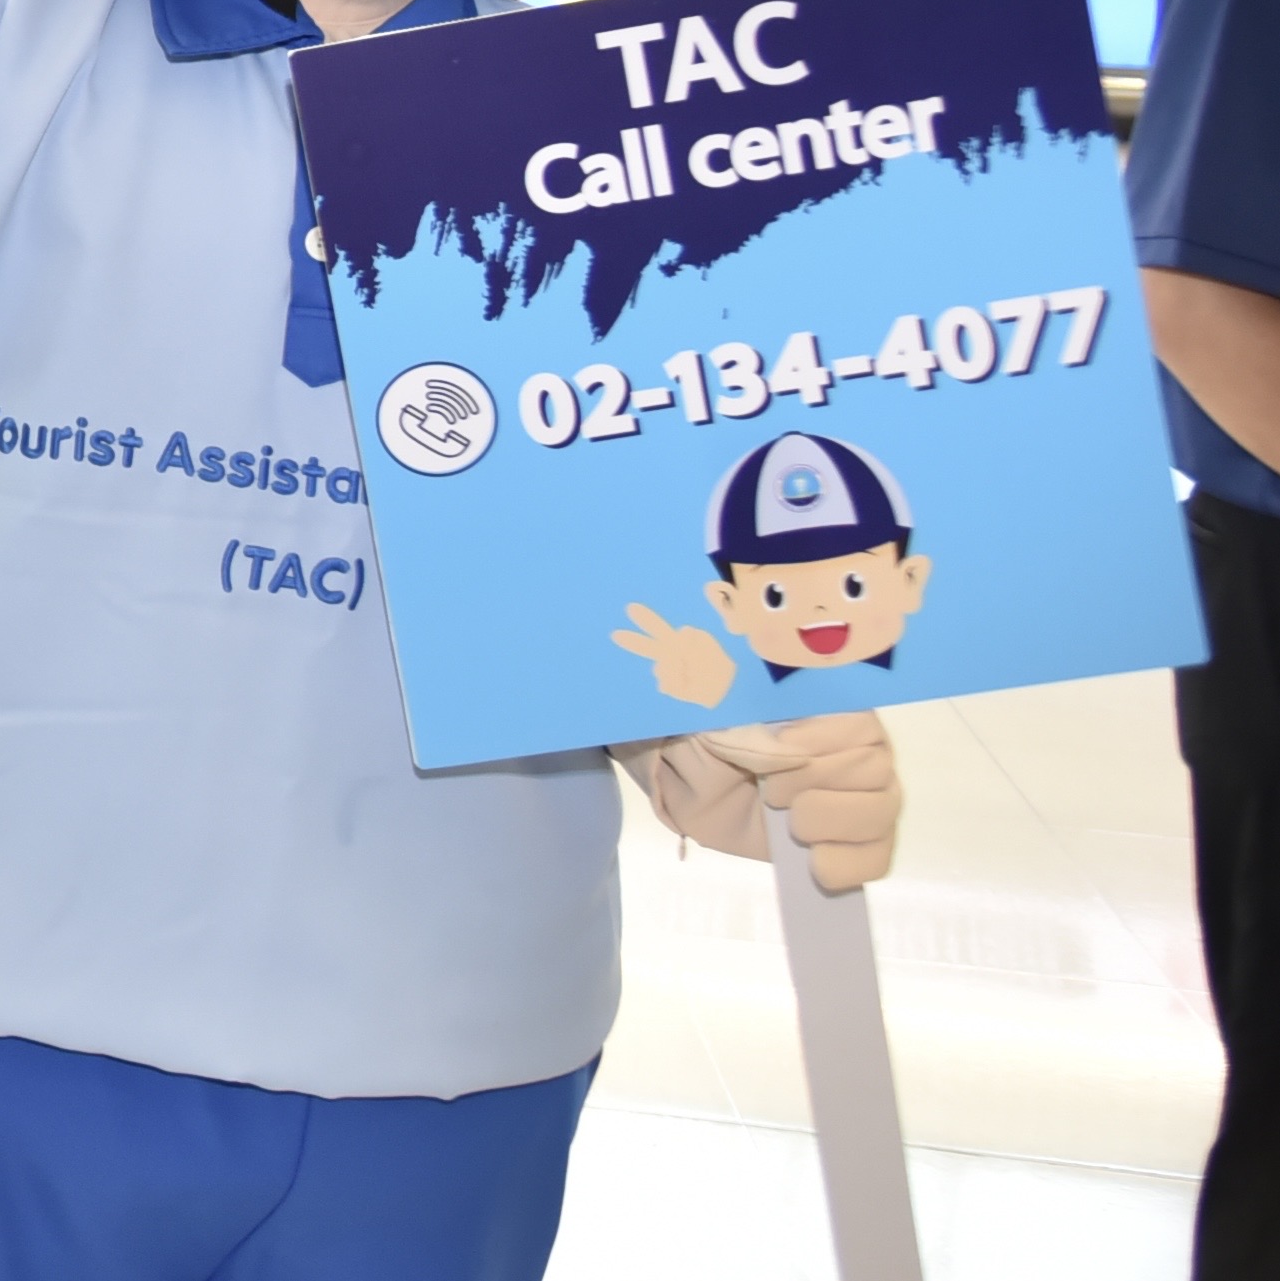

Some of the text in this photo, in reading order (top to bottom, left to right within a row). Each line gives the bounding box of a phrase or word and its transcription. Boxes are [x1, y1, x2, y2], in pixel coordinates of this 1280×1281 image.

[594, 0, 810, 109] TAC
[523, 94, 945, 215] Call center
[518, 285, 1107, 449] 02-134-4077
[220, 538, 366, 612] (TAC)
